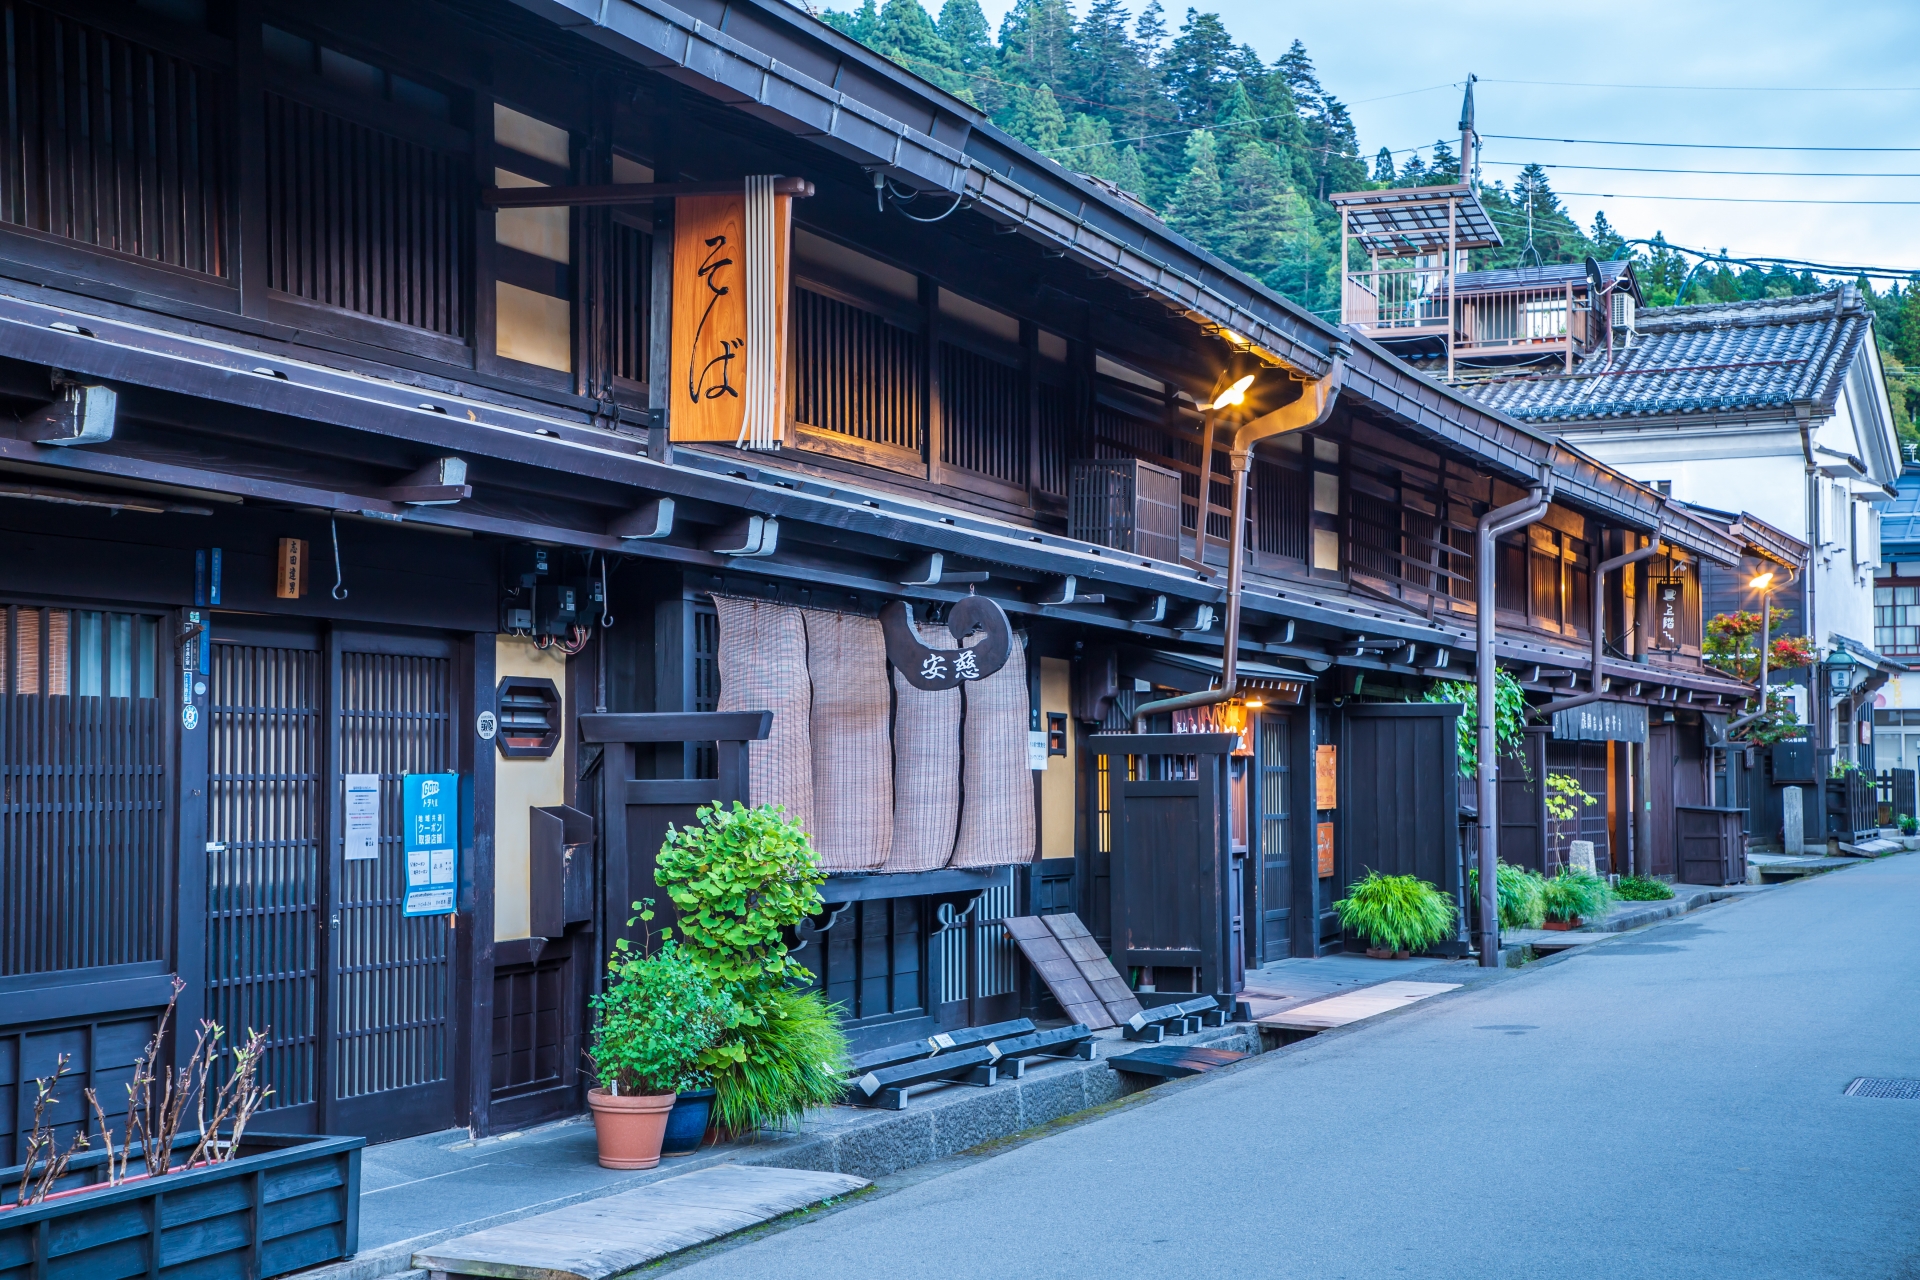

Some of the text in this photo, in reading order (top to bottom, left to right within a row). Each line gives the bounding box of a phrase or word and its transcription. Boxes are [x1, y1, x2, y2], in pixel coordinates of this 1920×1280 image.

[689, 235, 744, 404] そば
[418, 823, 442, 833] クーポン
[418, 834, 442, 845] 取扱店舗
